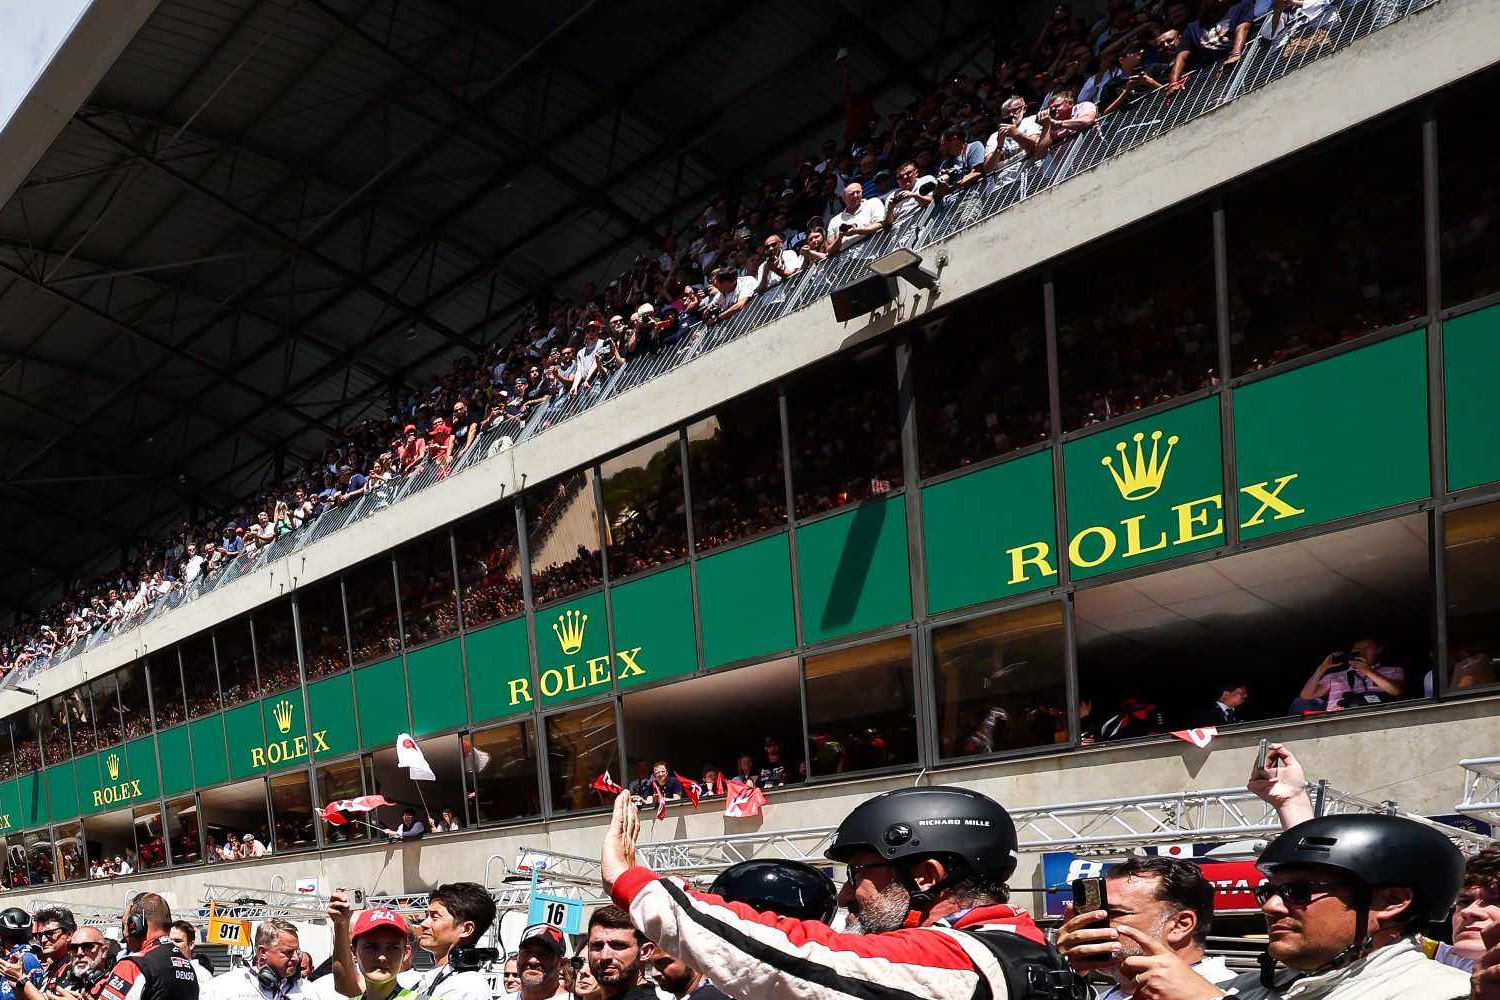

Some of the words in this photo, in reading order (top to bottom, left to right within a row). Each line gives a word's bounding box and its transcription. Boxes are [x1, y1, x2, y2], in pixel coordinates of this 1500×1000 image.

[1006, 473, 1305, 585] ROLEX
[507, 646, 647, 706] ROLEX
[250, 730, 330, 768] ROLEX
[92, 779, 143, 807] ROLEX
[964, 819, 990, 827] MILLE
[1066, 859, 1104, 885] 8
[547, 902, 565, 926] 16
[220, 923, 240, 940] 911
[175, 970, 195, 981] DENSO
[484, 976, 497, 991] 11
